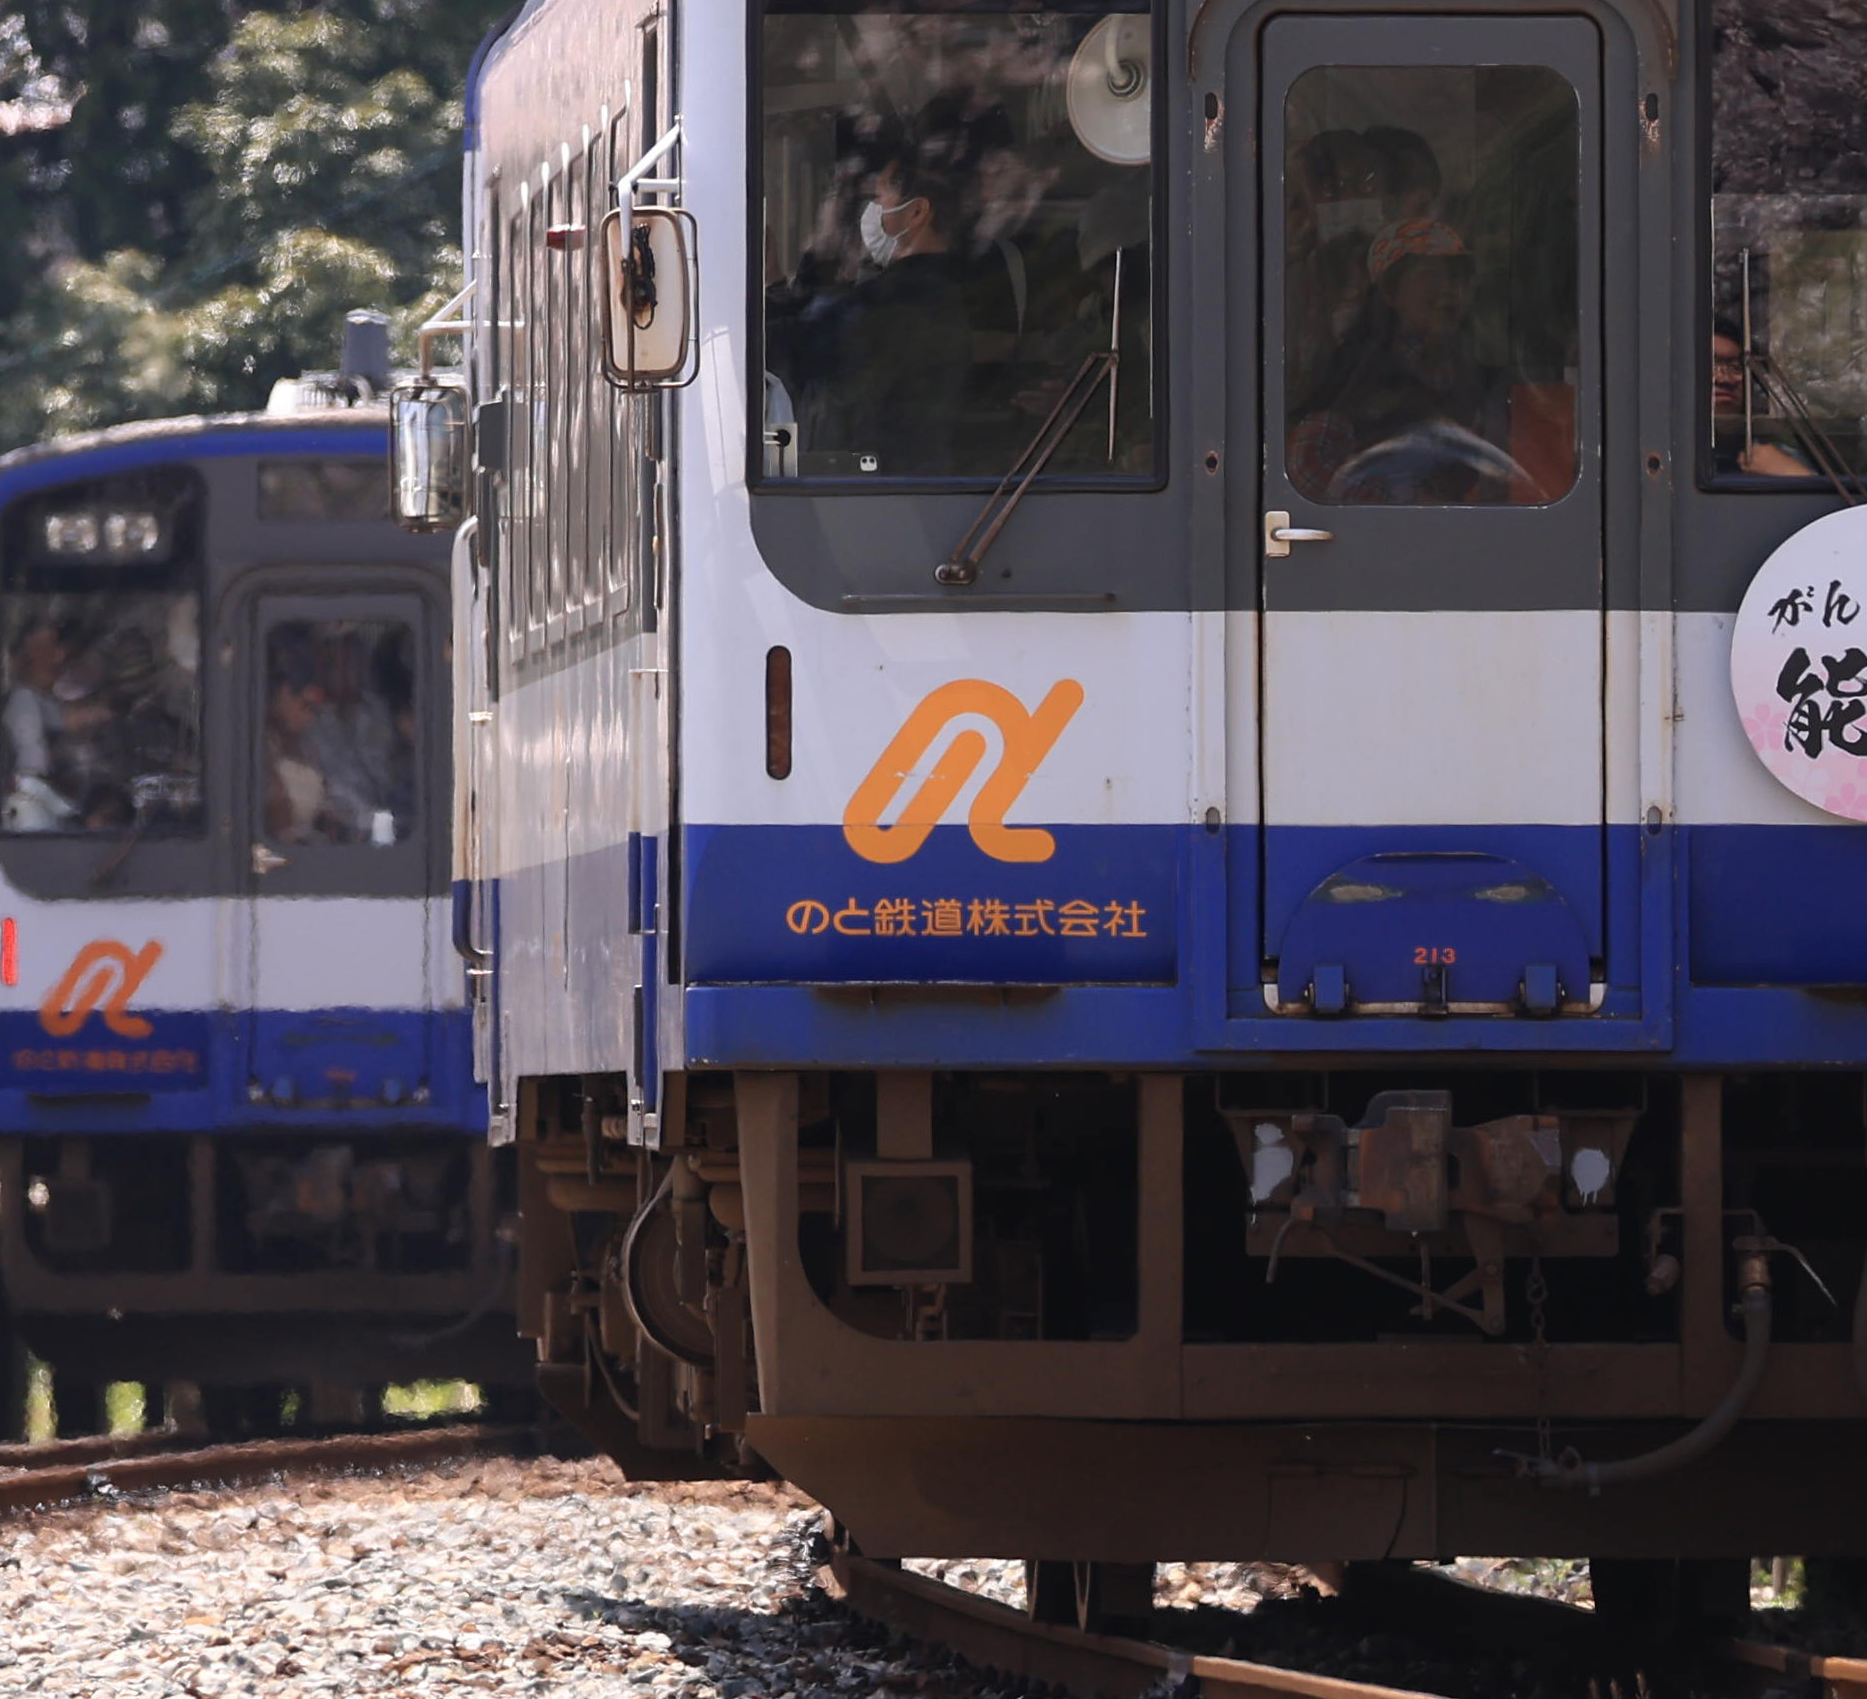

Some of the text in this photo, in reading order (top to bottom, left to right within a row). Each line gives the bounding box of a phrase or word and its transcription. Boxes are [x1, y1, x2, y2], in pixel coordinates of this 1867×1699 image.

[785, 897, 1149, 938] のと鉄道株式会社
[1413, 947, 1458, 965] 213
